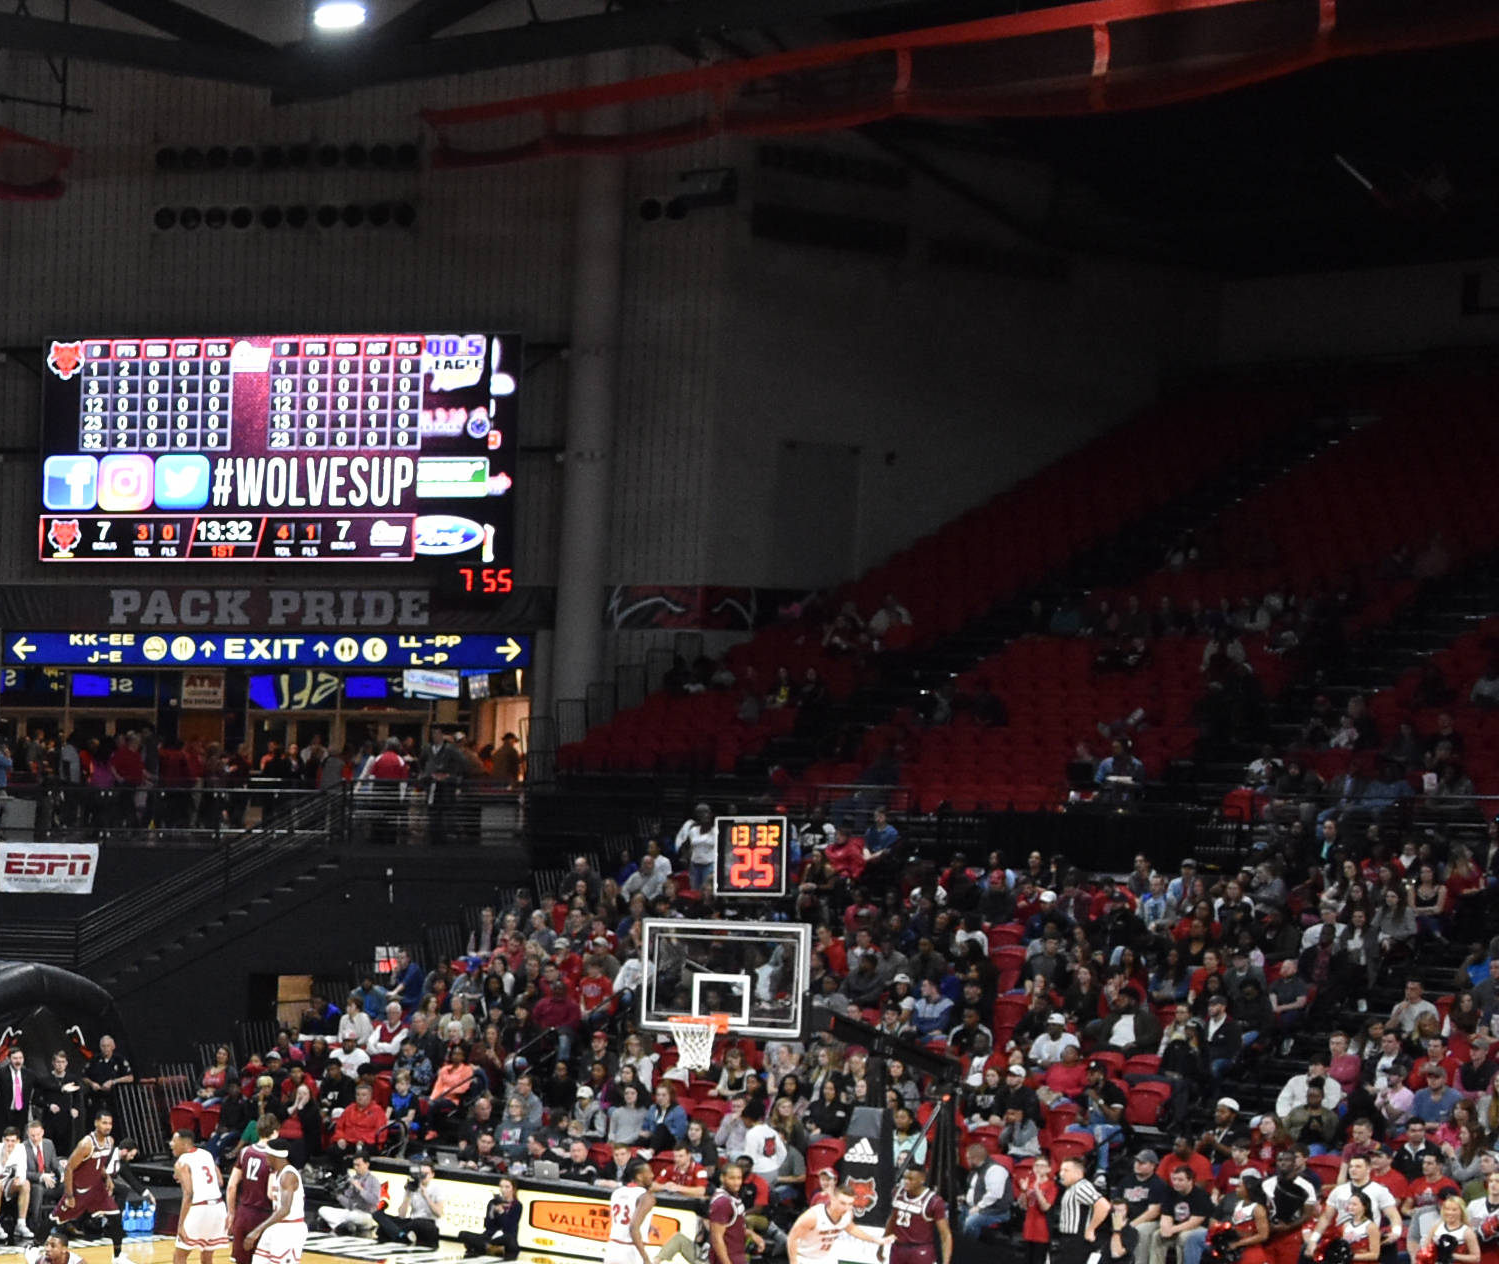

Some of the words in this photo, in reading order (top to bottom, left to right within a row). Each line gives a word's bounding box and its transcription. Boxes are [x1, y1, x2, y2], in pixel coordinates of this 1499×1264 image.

[117, 345, 136, 357] PTS
[306, 343, 325, 355] PTS
[91, 362, 98, 376] 1
[119, 361, 129, 376] 2
[149, 361, 159, 376] 0
[179, 361, 189, 375] 0
[210, 360, 220, 375] 0
[279, 360, 286, 374] 1
[309, 359, 319, 374] 0
[339, 359, 350, 374] 0
[369, 359, 380, 374] 0
[400, 359, 411, 373] 0
[89, 381, 99, 395] 3
[119, 380, 128, 394] 3
[148, 380, 159, 394] 0
[180, 380, 187, 394] 1
[210, 379, 220, 394] 0
[274, 379, 292, 393] 10
[308, 378, 318, 393] 0
[338, 378, 349, 393] 0
[370, 378, 378, 392] 1
[400, 377, 410, 392] 0
[85, 398, 103, 412] 12
[118, 398, 128, 412] 0
[148, 397, 158, 412] 0
[178, 397, 188, 412] 0
[209, 397, 219, 412] 0
[274, 397, 291, 411] 12
[307, 396, 318, 411] 0
[338, 396, 348, 411] 0
[368, 396, 379, 411] 0
[399, 395, 410, 411] 0
[84, 416, 102, 431] 23
[117, 416, 127, 430] 0
[147, 415, 158, 430] 0
[177, 415, 188, 430] 0
[208, 414, 219, 429] 0
[273, 414, 290, 429] 13
[306, 414, 317, 429] 0
[338, 414, 346, 428] 1
[369, 414, 377, 428] 1
[398, 413, 409, 428] 0
[83, 434, 102, 448] 32
[117, 435, 127, 448] 2
[147, 433, 157, 447] 0
[177, 433, 187, 447] 0
[208, 432, 218, 447] 0
[271, 432, 289, 447] 23
[306, 432, 316, 447] 0
[336, 432, 347, 446] 0
[367, 431, 377, 446] 0
[397, 431, 408, 446] 0
[212, 456, 413, 507] #WOLVESUP
[97, 522, 112, 540] 7
[137, 525, 148, 539] 3
[162, 525, 173, 539] 0
[197, 521, 253, 541] 13:32
[277, 525, 289, 539] 4
[306, 525, 314, 539] 1
[336, 521, 351, 540] 7
[211, 546, 235, 557] 1ST
[109, 589, 251, 626] PACK
[267, 590, 430, 625] PRIDE
[69, 634, 135, 647] KK-EE
[224, 639, 304, 659] EXIT
[398, 635, 461, 648] LL-PP
[88, 651, 122, 663] J-E
[410, 652, 448, 664] L-P
[5, 852, 92, 876] ESPN
[730, 847, 774, 888] 25
[844, 1153, 879, 1164] adidas
[201, 1166, 213, 1184] 3
[246, 1157, 262, 1181] 12
[549, 1212, 610, 1230] VALLEY
[896, 1210, 912, 1228] 23
